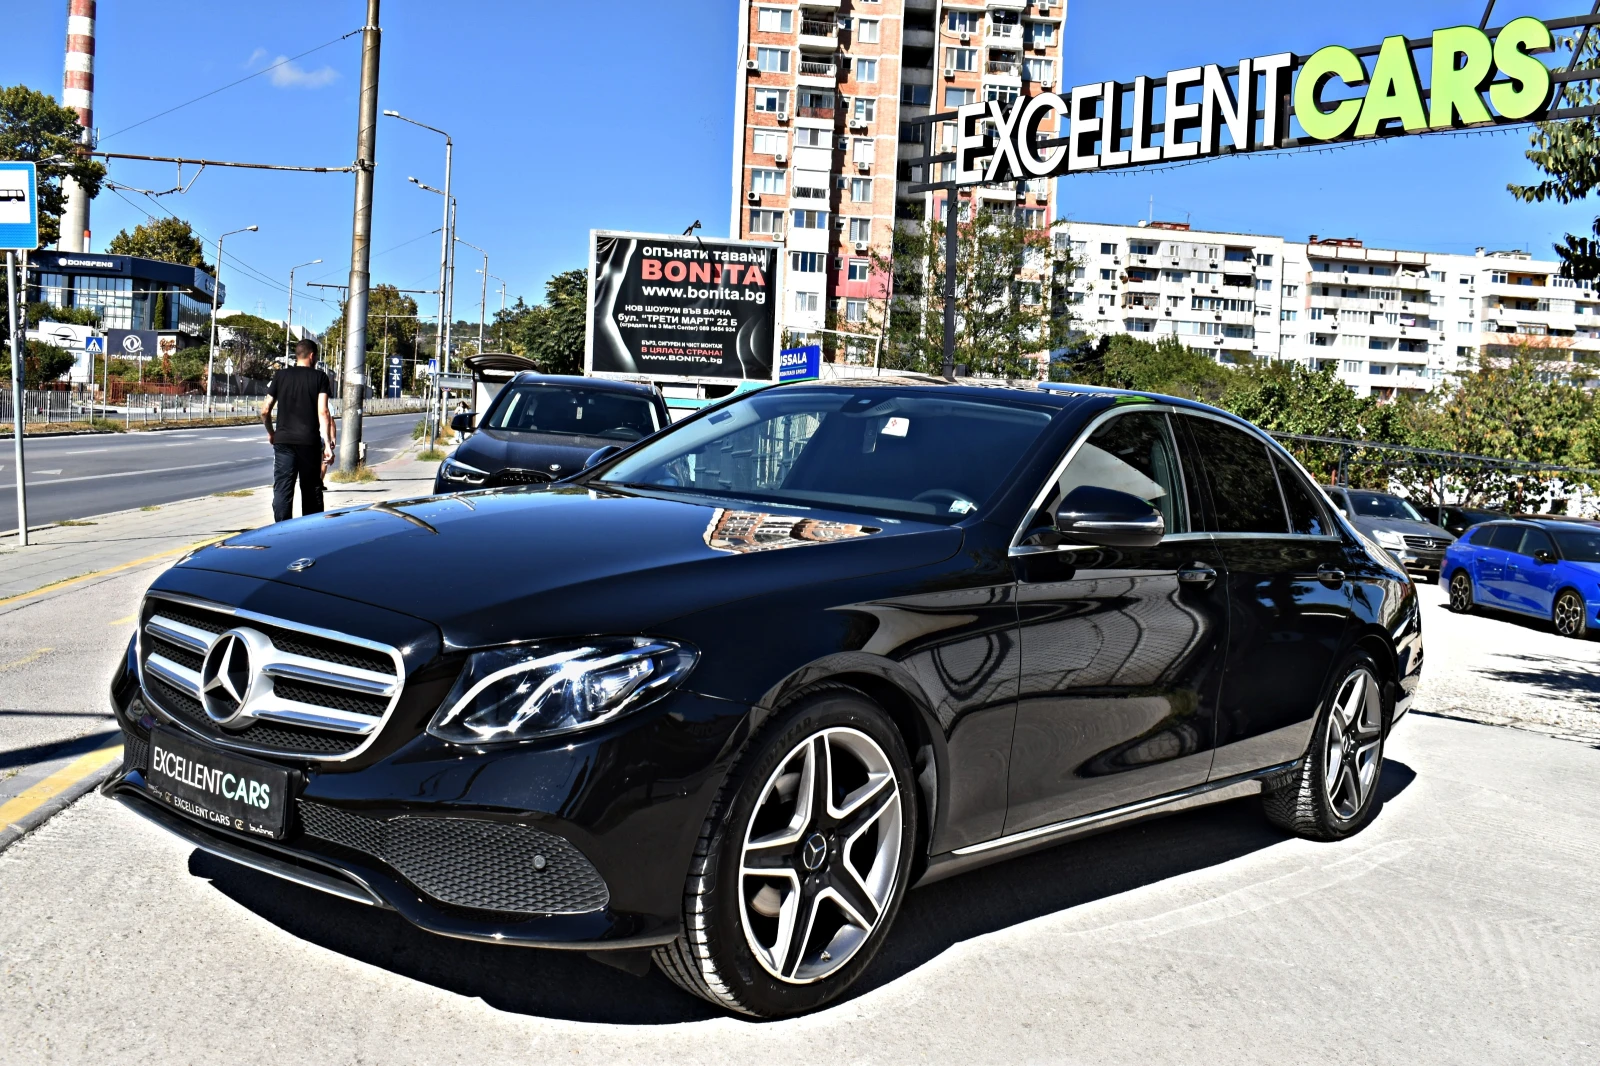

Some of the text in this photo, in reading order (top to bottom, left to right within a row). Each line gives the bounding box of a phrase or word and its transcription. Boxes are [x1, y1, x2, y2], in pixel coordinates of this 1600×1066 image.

[642, 246, 766, 263] опънати тавани
[67, 259, 113, 268] DONGFENG
[641, 259, 766, 286] BONITA
[642, 286, 766, 304] www.bonita.bg
[625, 304, 731, 316] НОВ ШОУРУМ ВЪВ ВАРНА
[618, 314, 638, 322] бул.
[716, 318, 727, 326] 22
[730, 318, 738, 326] Б
[641, 354, 723, 364] www.BONITA.bg
[174, 796, 208, 820] EXCELLENT
[209, 811, 231, 827] CARS
